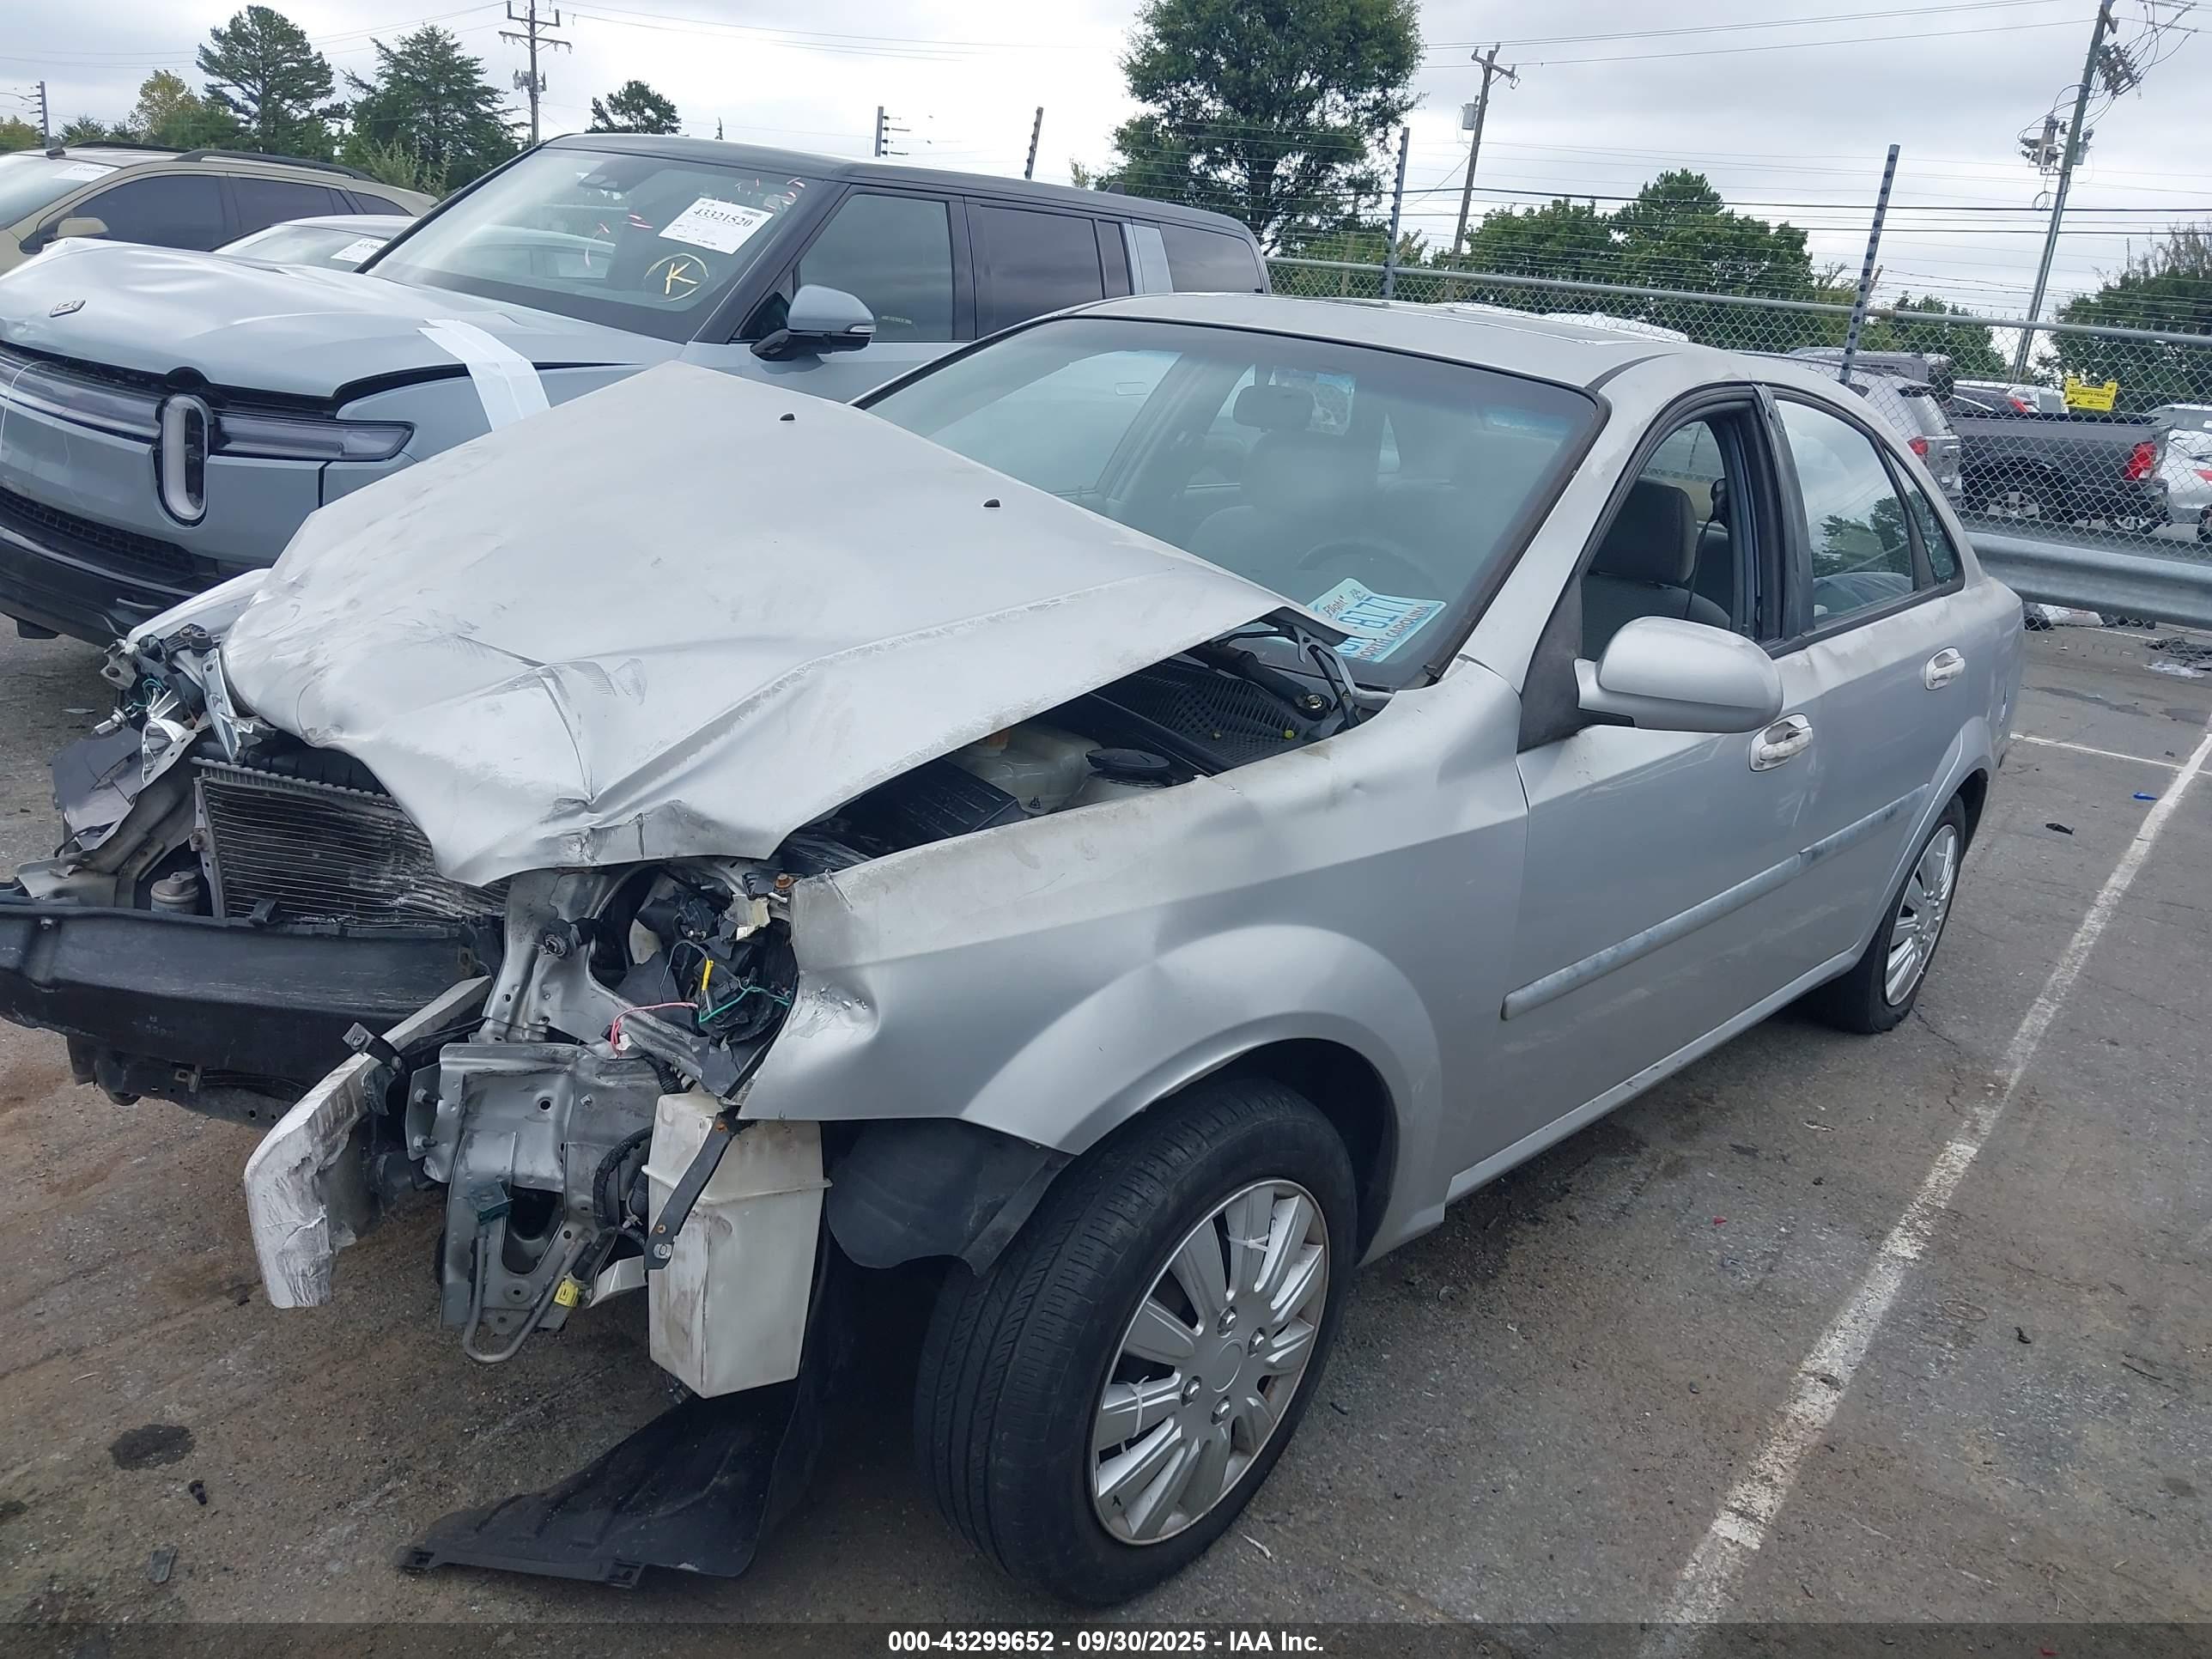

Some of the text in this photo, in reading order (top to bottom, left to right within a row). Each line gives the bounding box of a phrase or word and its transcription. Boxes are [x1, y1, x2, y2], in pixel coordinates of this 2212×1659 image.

[694, 208, 754, 228] 43321520
[665, 262, 699, 295] K
[1386, 605, 1431, 638] CAROLINA
